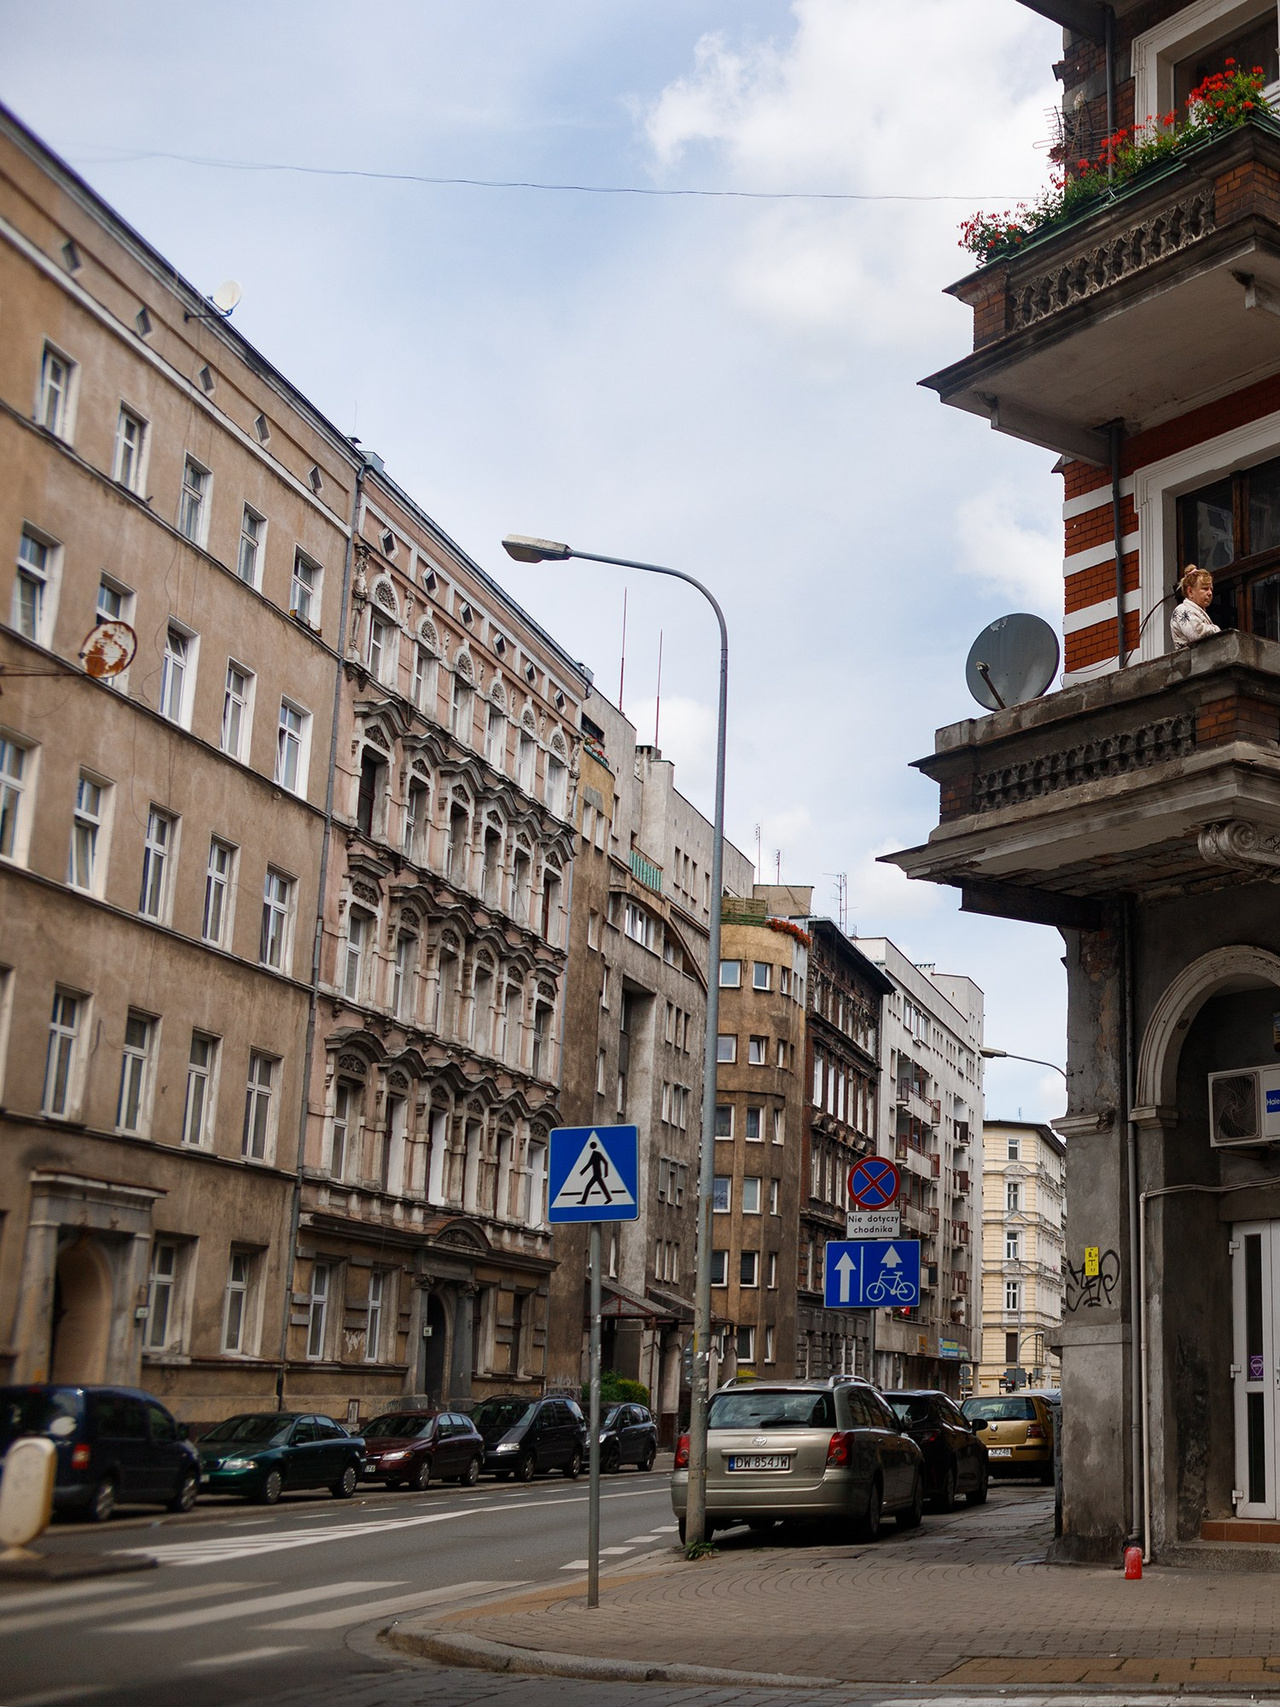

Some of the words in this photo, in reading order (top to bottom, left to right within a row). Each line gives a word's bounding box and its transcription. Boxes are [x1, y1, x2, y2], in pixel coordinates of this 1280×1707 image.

[848, 1215, 863, 1223] Nie
[867, 1215, 899, 1224] dotyczy
[735, 1456, 751, 1468] DW
[754, 1456, 788, 1468] 854JW
